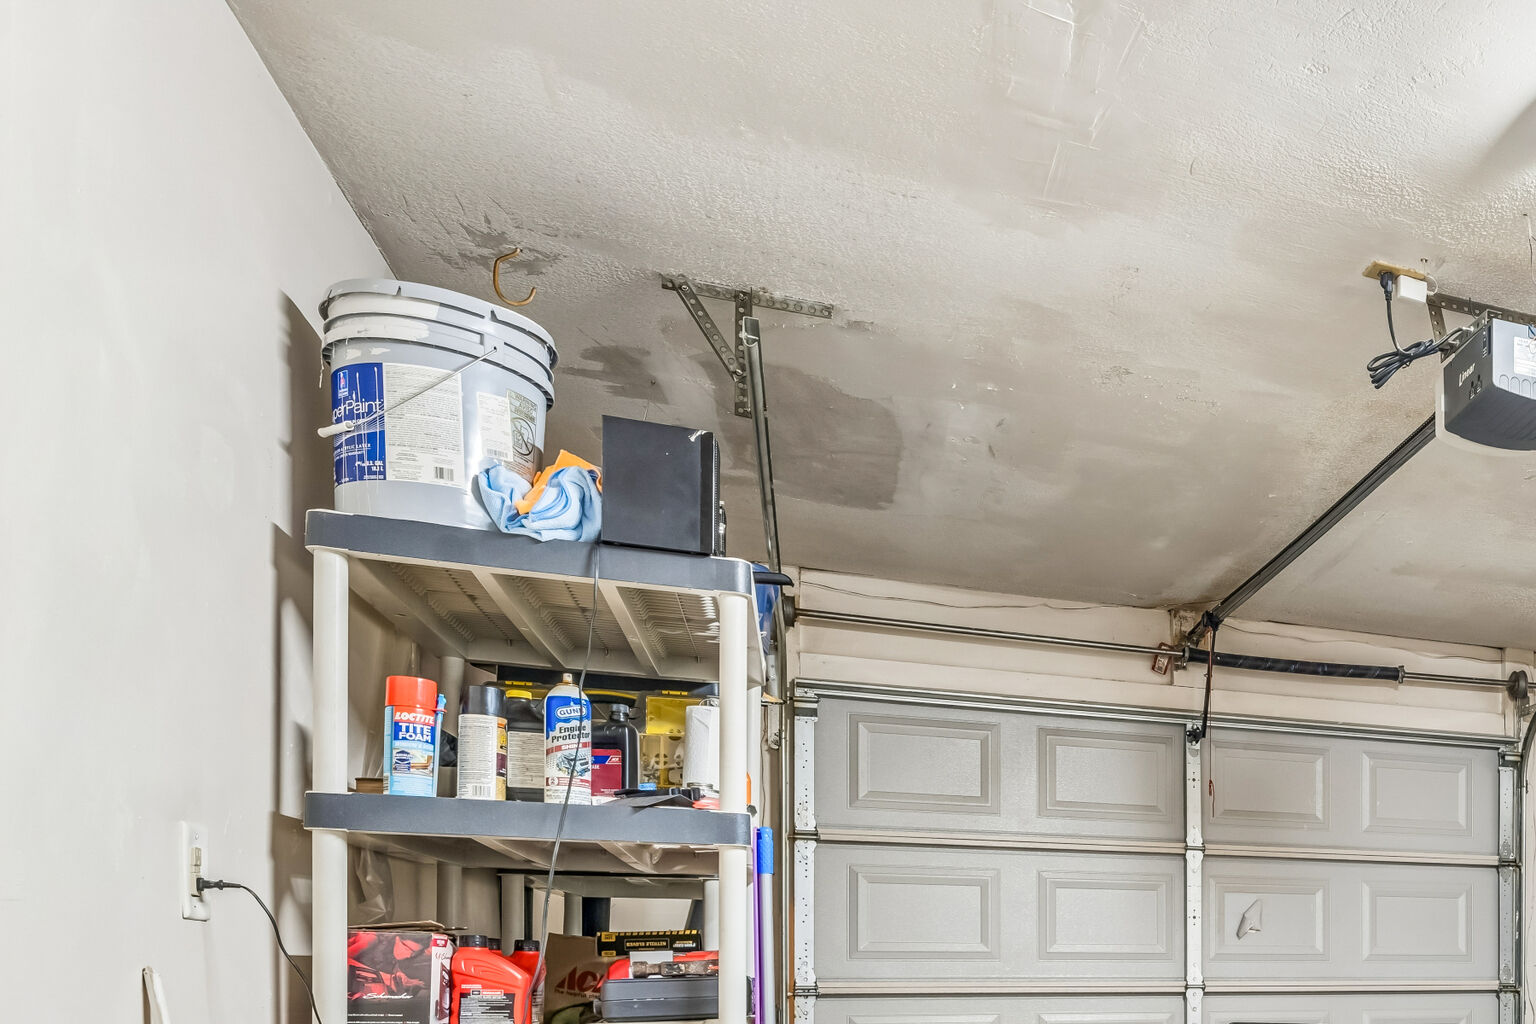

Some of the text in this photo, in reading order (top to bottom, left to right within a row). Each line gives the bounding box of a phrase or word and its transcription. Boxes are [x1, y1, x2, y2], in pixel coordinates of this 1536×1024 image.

[1458, 363, 1476, 387] Linear
[394, 711, 435, 724] LOCTITE
[398, 722, 432, 735] TITE
[398, 732, 432, 743] FOAM
